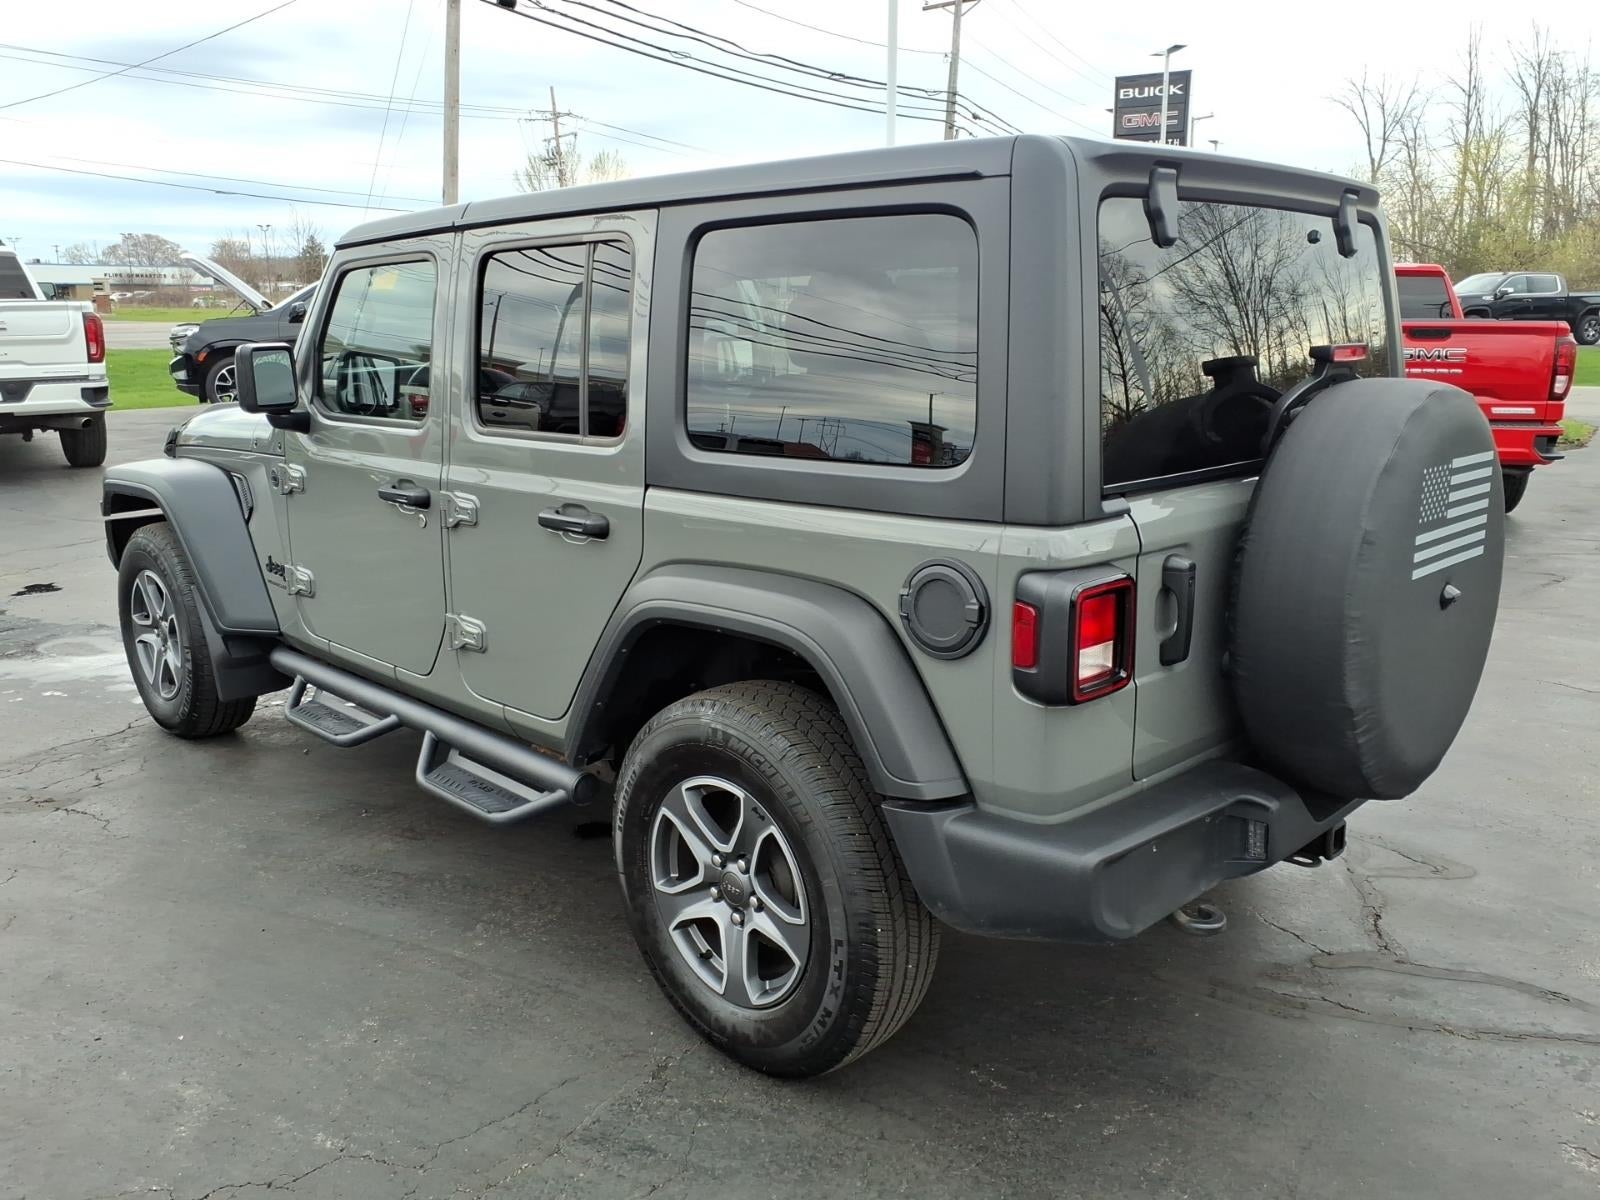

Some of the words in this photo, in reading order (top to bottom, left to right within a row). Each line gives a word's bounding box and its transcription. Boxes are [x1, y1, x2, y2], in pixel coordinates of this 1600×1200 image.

[1119, 84, 1184, 99] BUICK
[1122, 110, 1179, 129] GMC
[726, 736, 813, 825] MICHELIN
[829, 938, 844, 998] LTX
